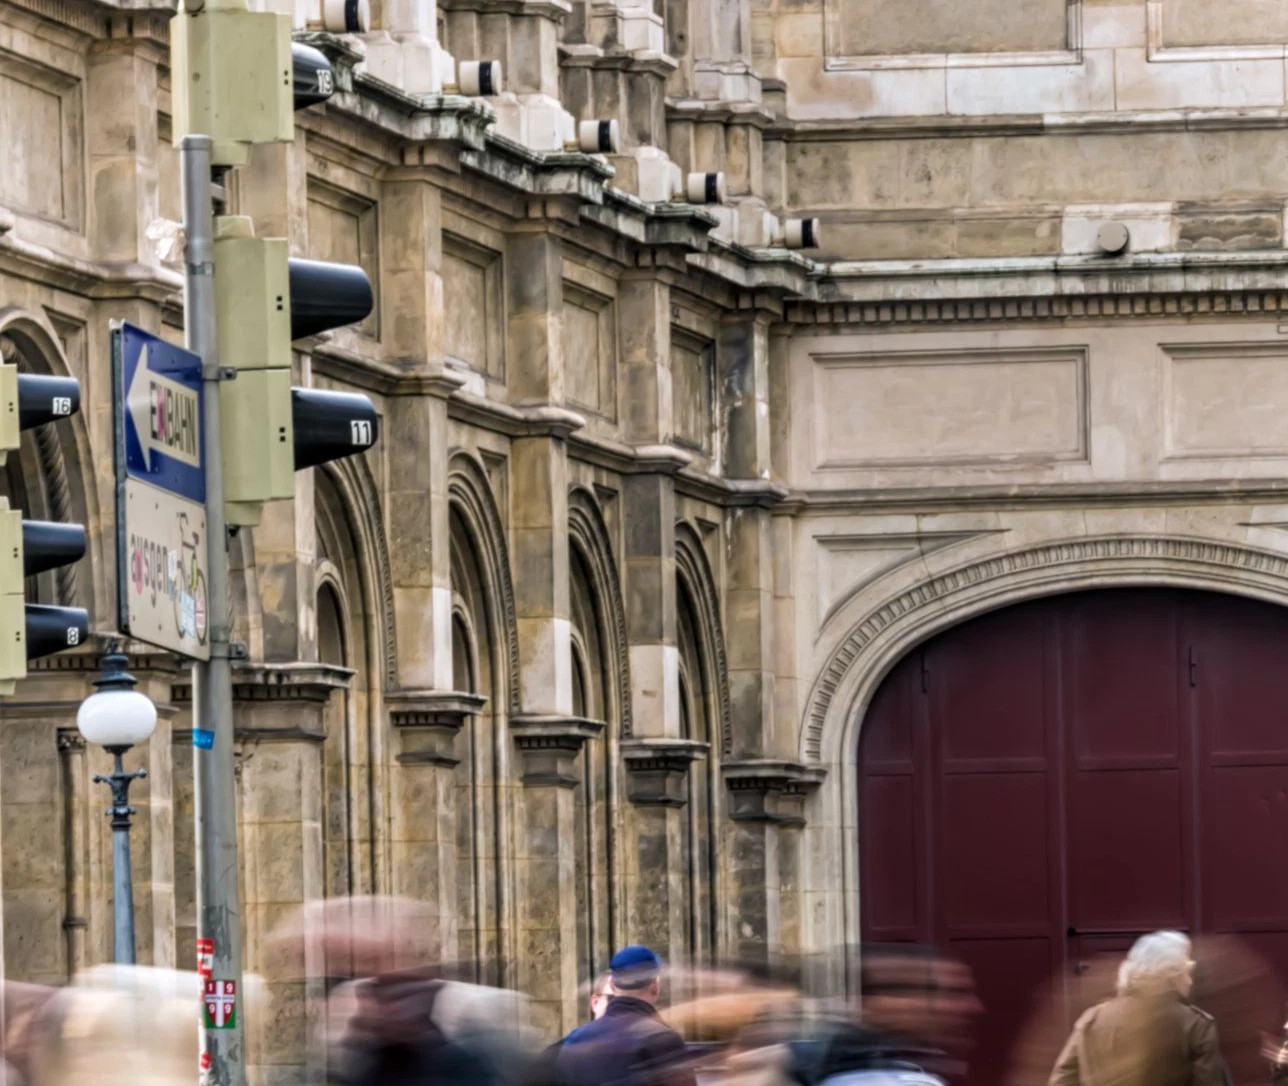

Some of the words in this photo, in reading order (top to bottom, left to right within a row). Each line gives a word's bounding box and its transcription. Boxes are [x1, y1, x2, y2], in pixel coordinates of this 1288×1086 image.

[318, 70, 332, 92] 19
[56, 399, 70, 413] 16
[353, 422, 369, 443] 11
